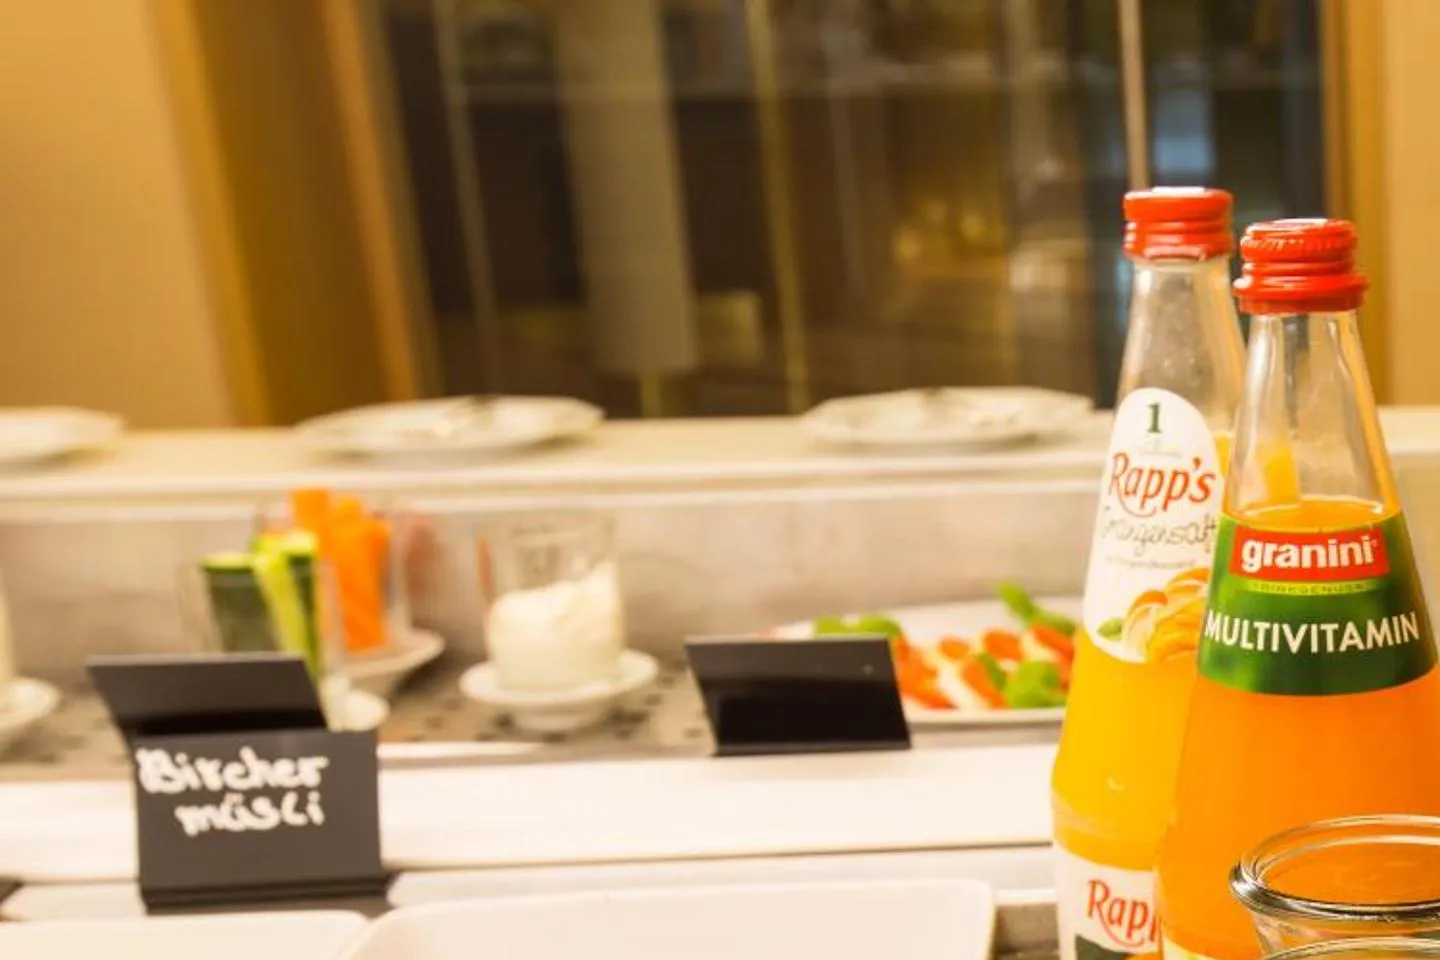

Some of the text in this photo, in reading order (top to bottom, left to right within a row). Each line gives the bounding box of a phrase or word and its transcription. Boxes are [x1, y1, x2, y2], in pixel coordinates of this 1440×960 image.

[1146, 402, 1162, 434] 1
[1108, 452, 1216, 518] Rapp's
[1241, 534, 1374, 574] granini
[1204, 611, 1420, 655] MULTIVITAMIN
[135, 746, 330, 793] Bircher
